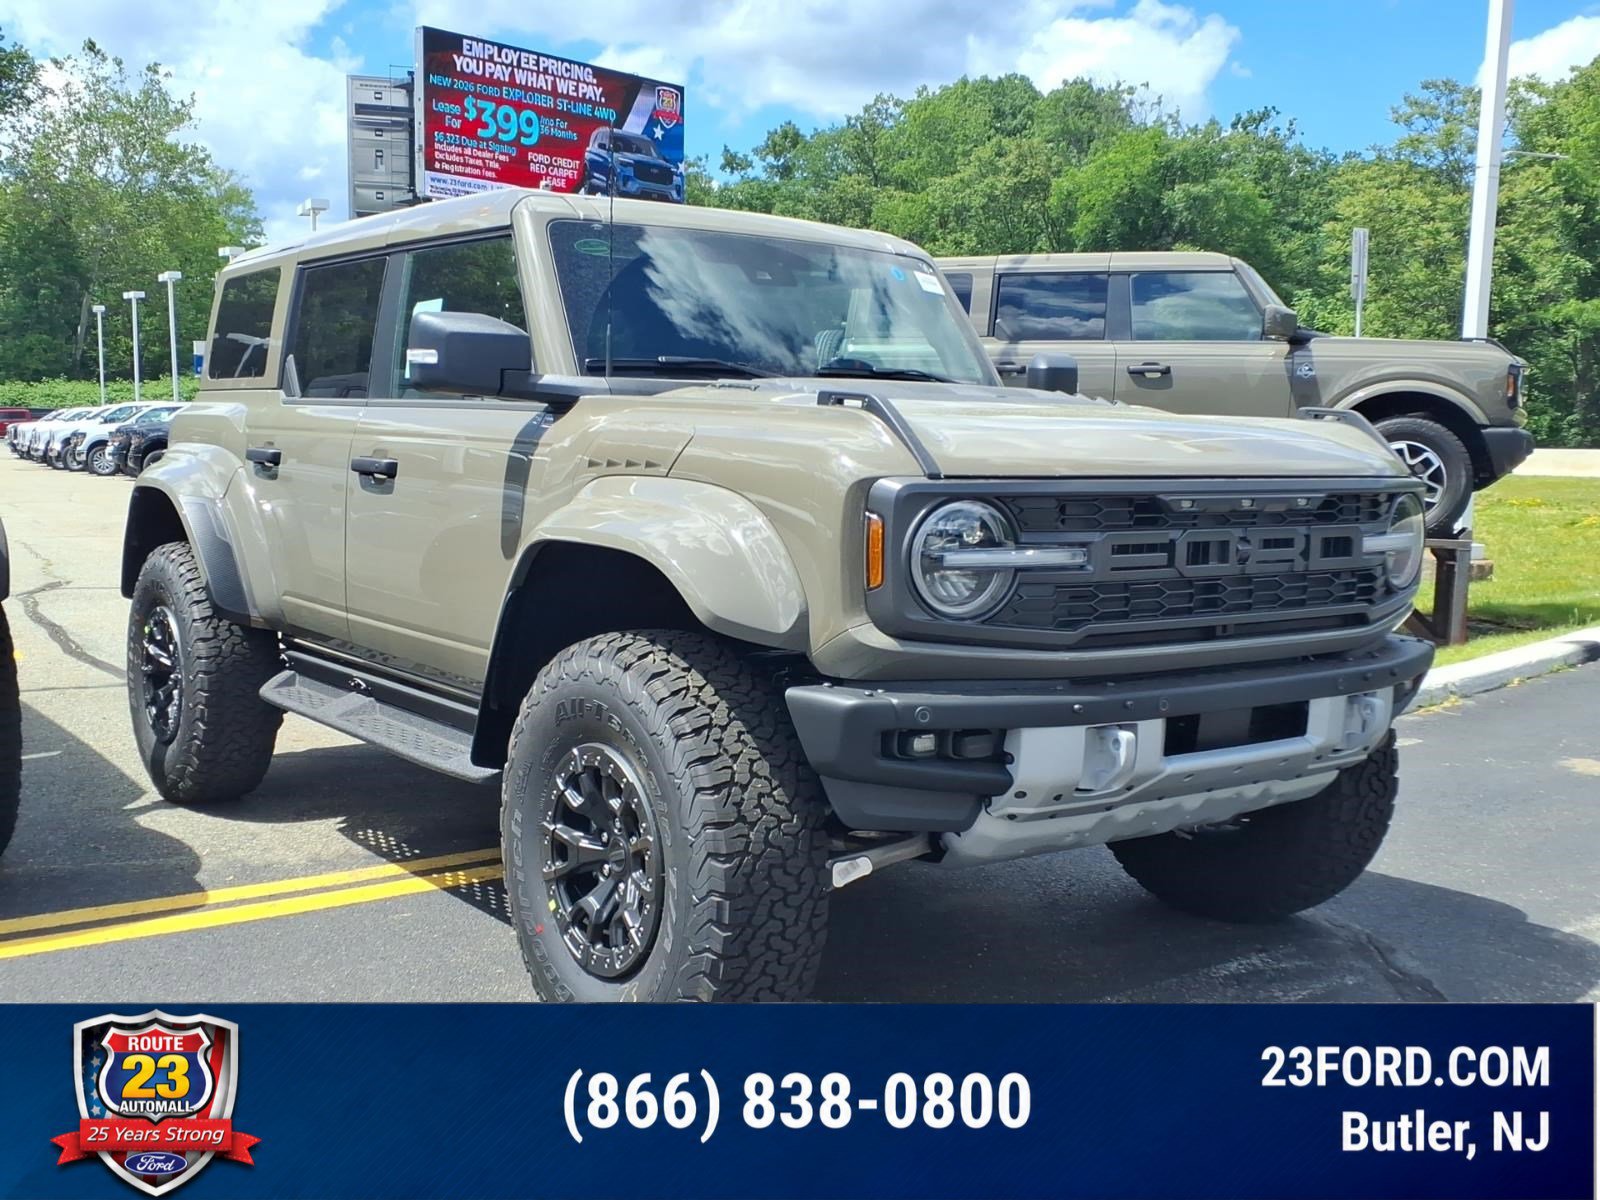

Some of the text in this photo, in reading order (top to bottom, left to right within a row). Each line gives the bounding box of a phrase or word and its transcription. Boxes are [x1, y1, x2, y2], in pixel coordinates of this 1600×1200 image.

[462, 38, 597, 84] EMPLOYEE PRICING.
[452, 54, 605, 103] YOU PAY WHAT WE PAY.
[429, 74, 616, 121] NEW 2026 FORD EXPLORER ST-LINE 4WD
[432, 94, 539, 146] Lease $399
[444, 115, 462, 128] For
[555, 118, 568, 129] For
[540, 125, 578, 140] 36 Months
[434, 142, 462, 153] Includes
[473, 148, 494, 160] Dealer
[461, 136, 477, 148] Due
[479, 140, 487, 149] at
[488, 141, 516, 157] Signing
[528, 152, 580, 170] FORD CREDIT
[530, 163, 578, 180] RED CARPET
[429, 176, 488, 191] www.23ford.com
[1092, 524, 1364, 581] FORD
